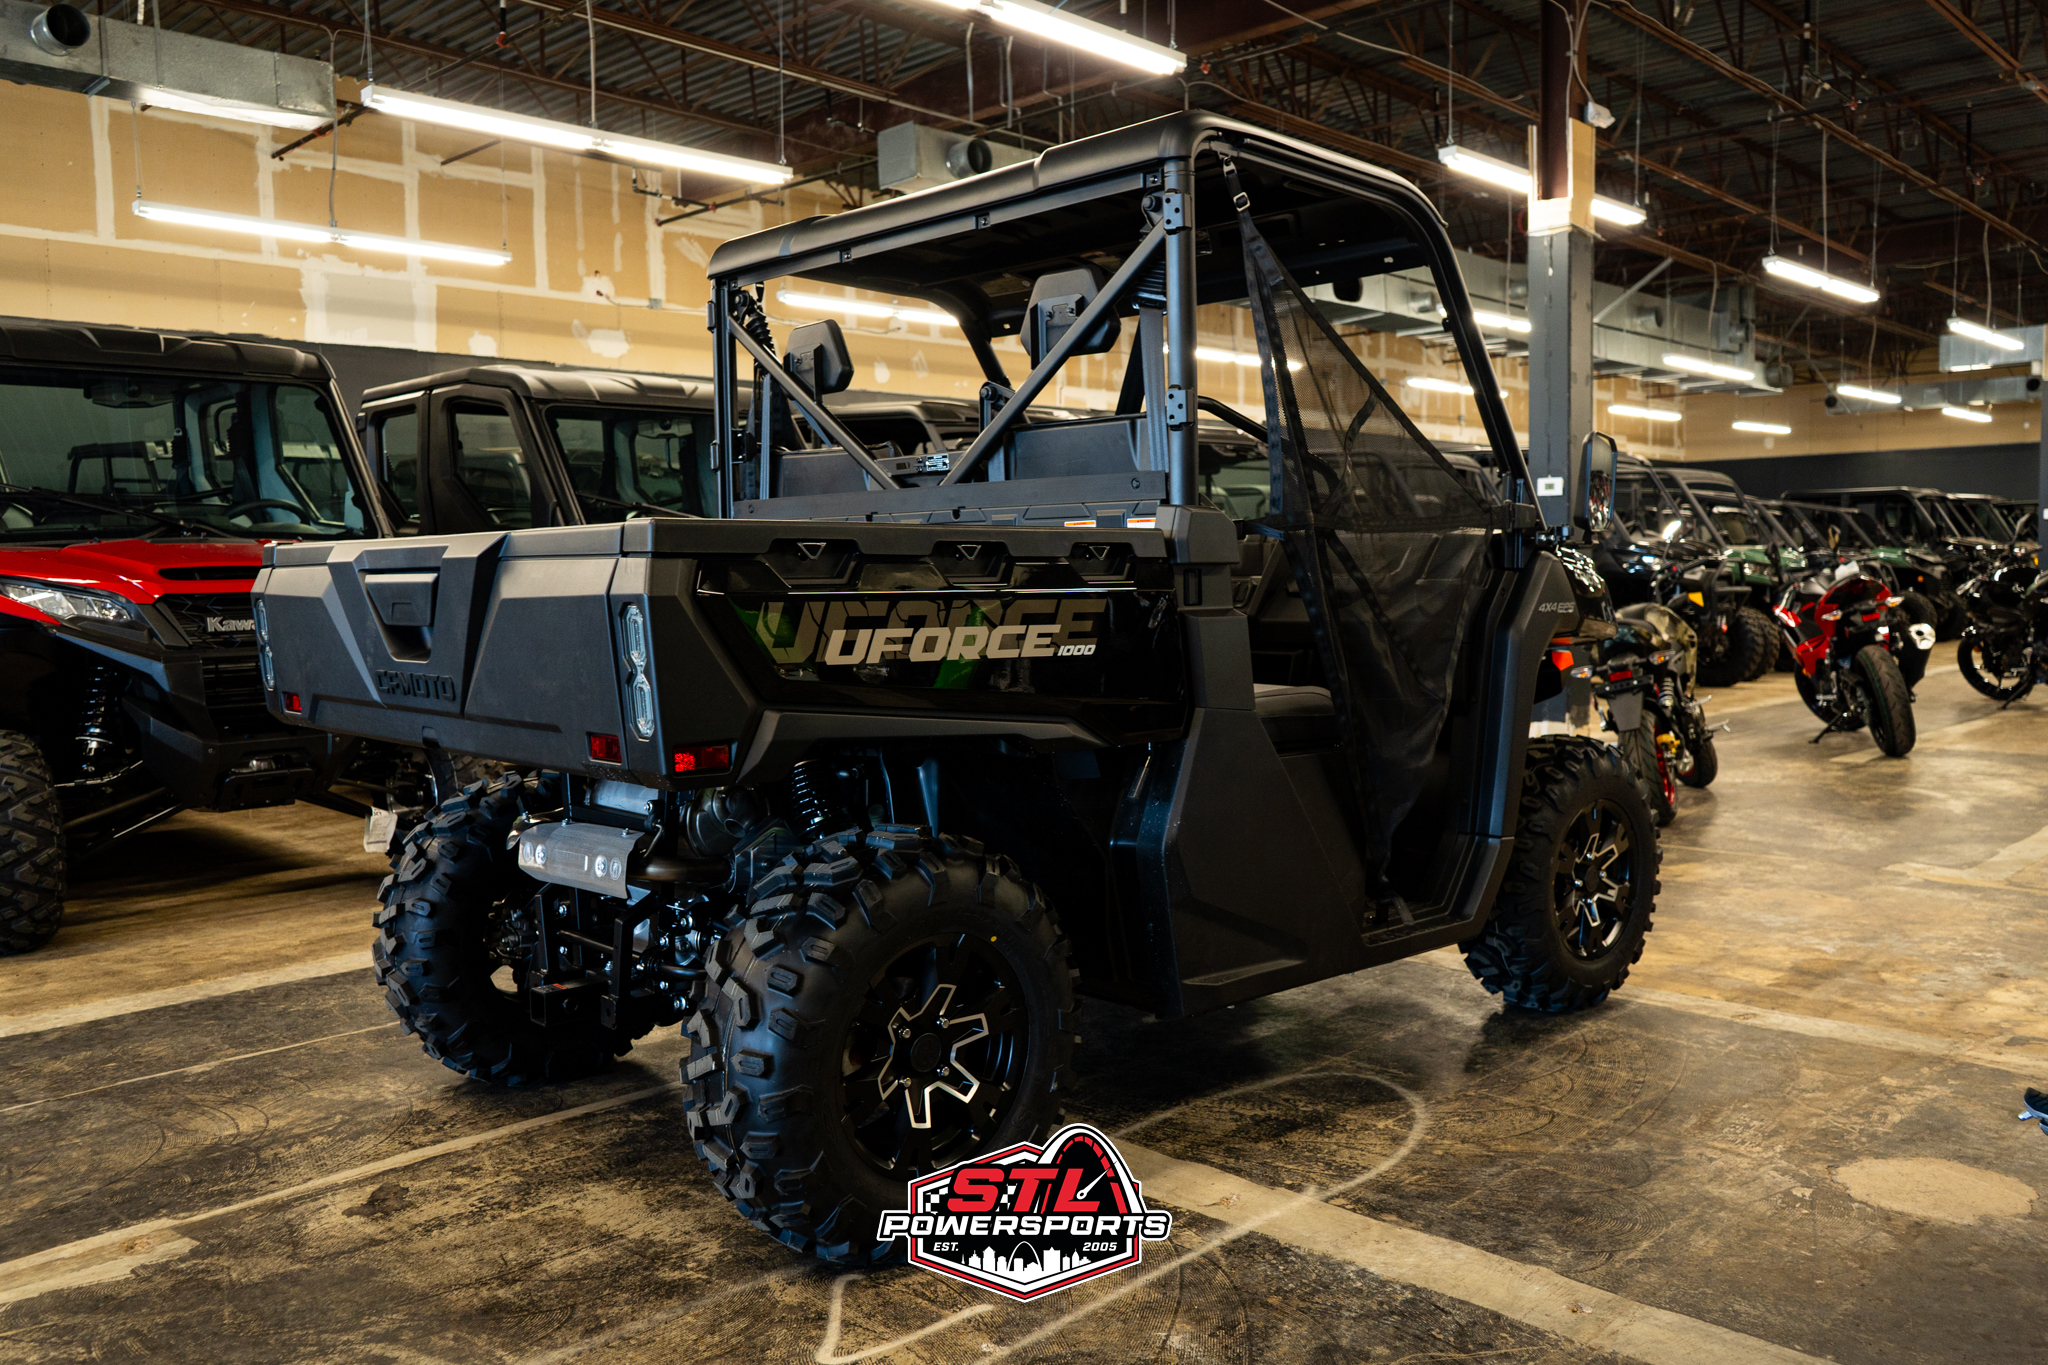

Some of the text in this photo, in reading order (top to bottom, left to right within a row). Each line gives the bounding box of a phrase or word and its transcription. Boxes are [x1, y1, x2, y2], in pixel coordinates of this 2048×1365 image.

[824, 624, 1097, 666] UFORCE 1000
[375, 669, 456, 701] CFMOTO
